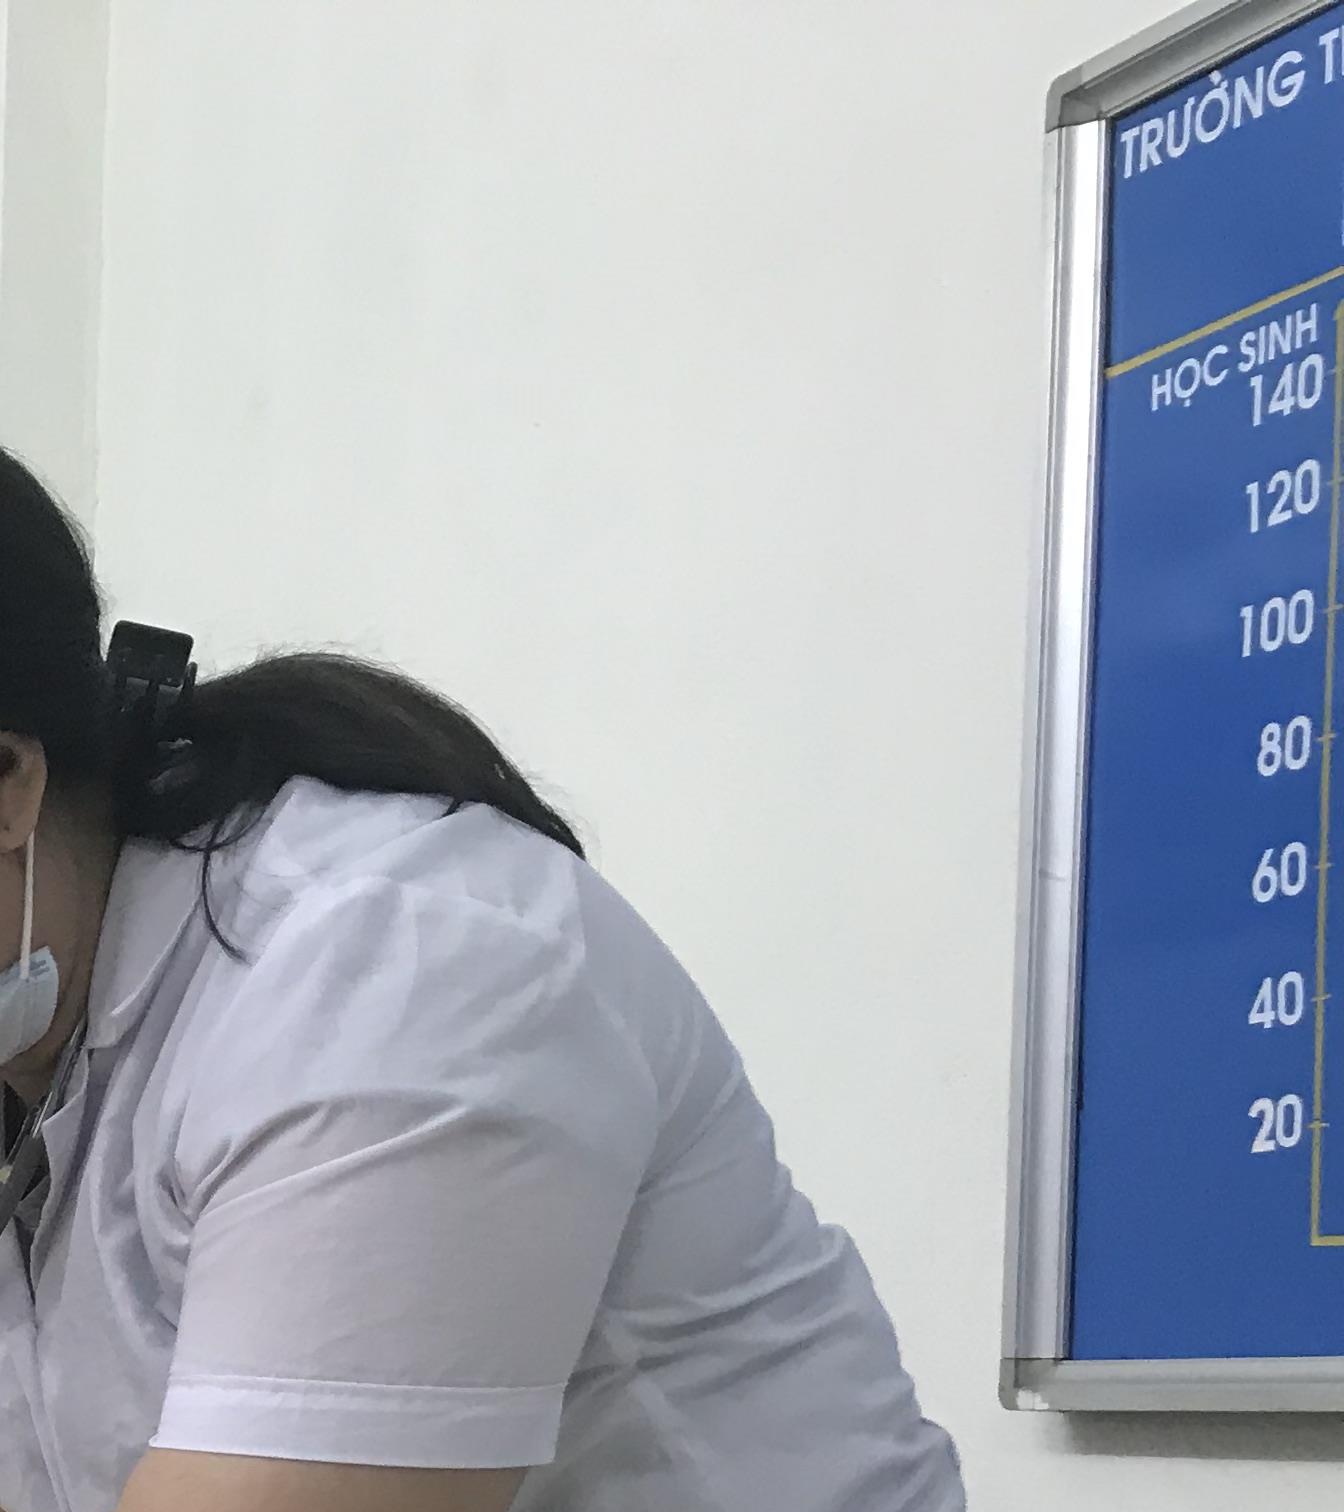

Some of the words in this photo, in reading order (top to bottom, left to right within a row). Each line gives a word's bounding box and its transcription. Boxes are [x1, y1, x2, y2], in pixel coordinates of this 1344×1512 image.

[1120, 50, 1306, 179] TRƯỜNG
[1151, 344, 1229, 411] HỌC
[1237, 303, 1318, 373] SINH
[1250, 353, 1324, 427] 140
[1246, 459, 1320, 533] 120
[1240, 589, 1314, 657] 100
[1257, 715, 1311, 777] 80
[1252, 841, 1307, 903] 60
[1248, 971, 1304, 1029] 40
[1248, 1094, 1303, 1154] 20
